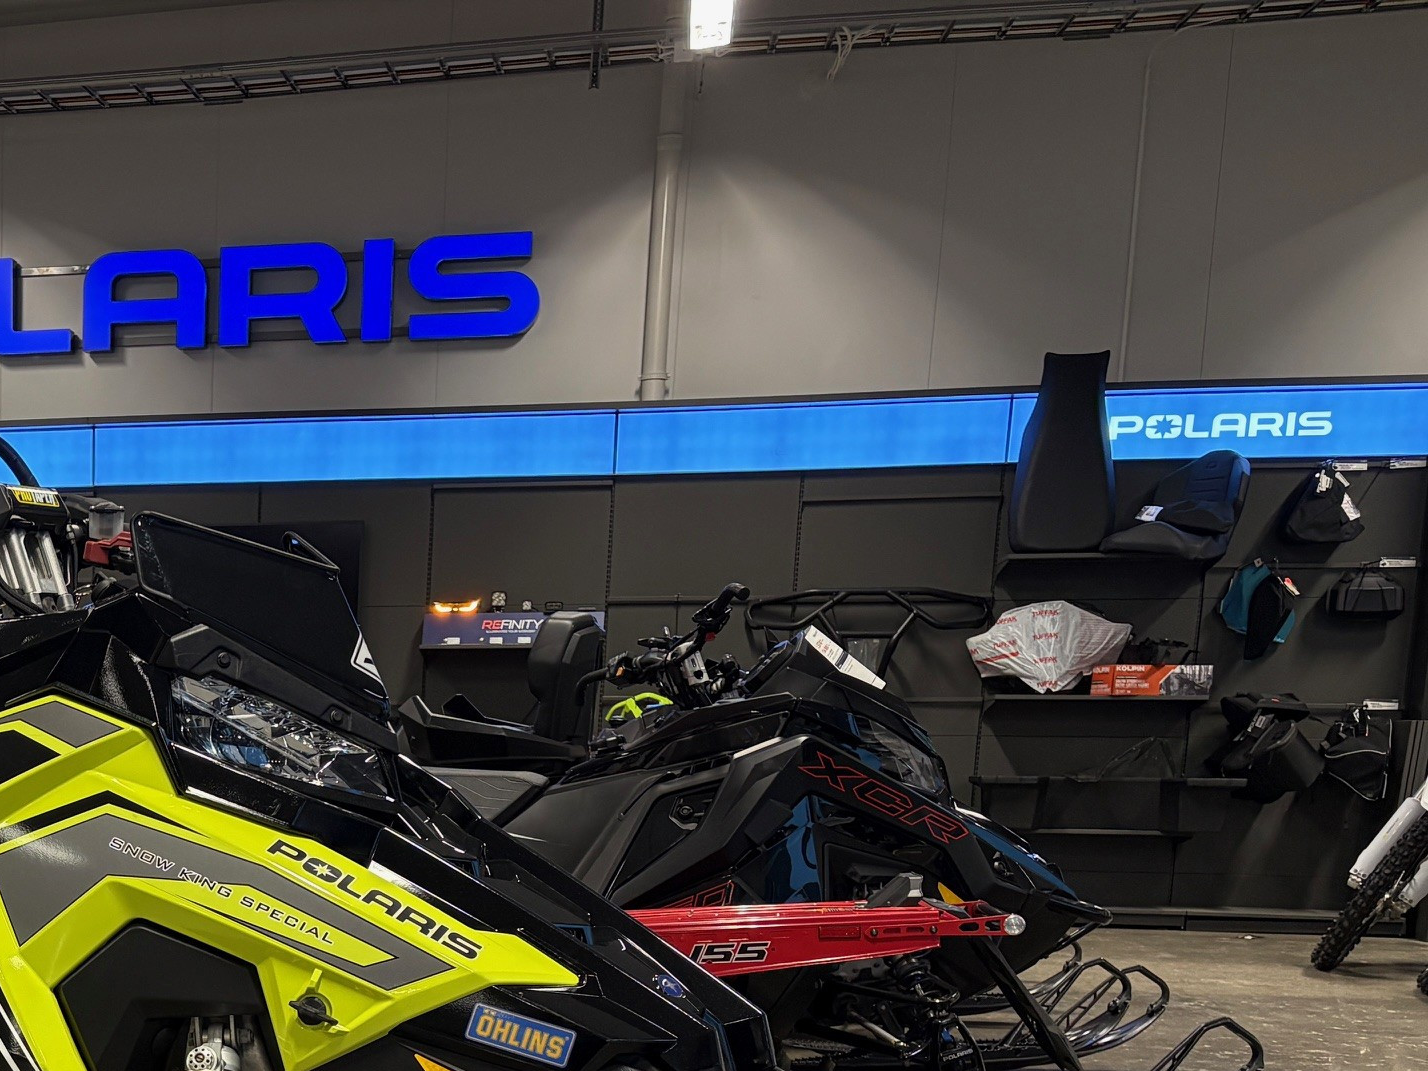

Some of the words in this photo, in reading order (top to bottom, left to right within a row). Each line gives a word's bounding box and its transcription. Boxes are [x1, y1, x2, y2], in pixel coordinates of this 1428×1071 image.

[1109, 411, 1333, 440] POLARIS
[482, 619, 544, 630] REFINITY
[798, 751, 969, 844] XCR
[109, 836, 175, 872] SNOW
[177, 868, 232, 899] KING
[239, 895, 334, 946] SPECIAL
[266, 838, 483, 961] POLARIS
[688, 940, 771, 964] 155
[476, 1008, 566, 1060] ÖHLINS
